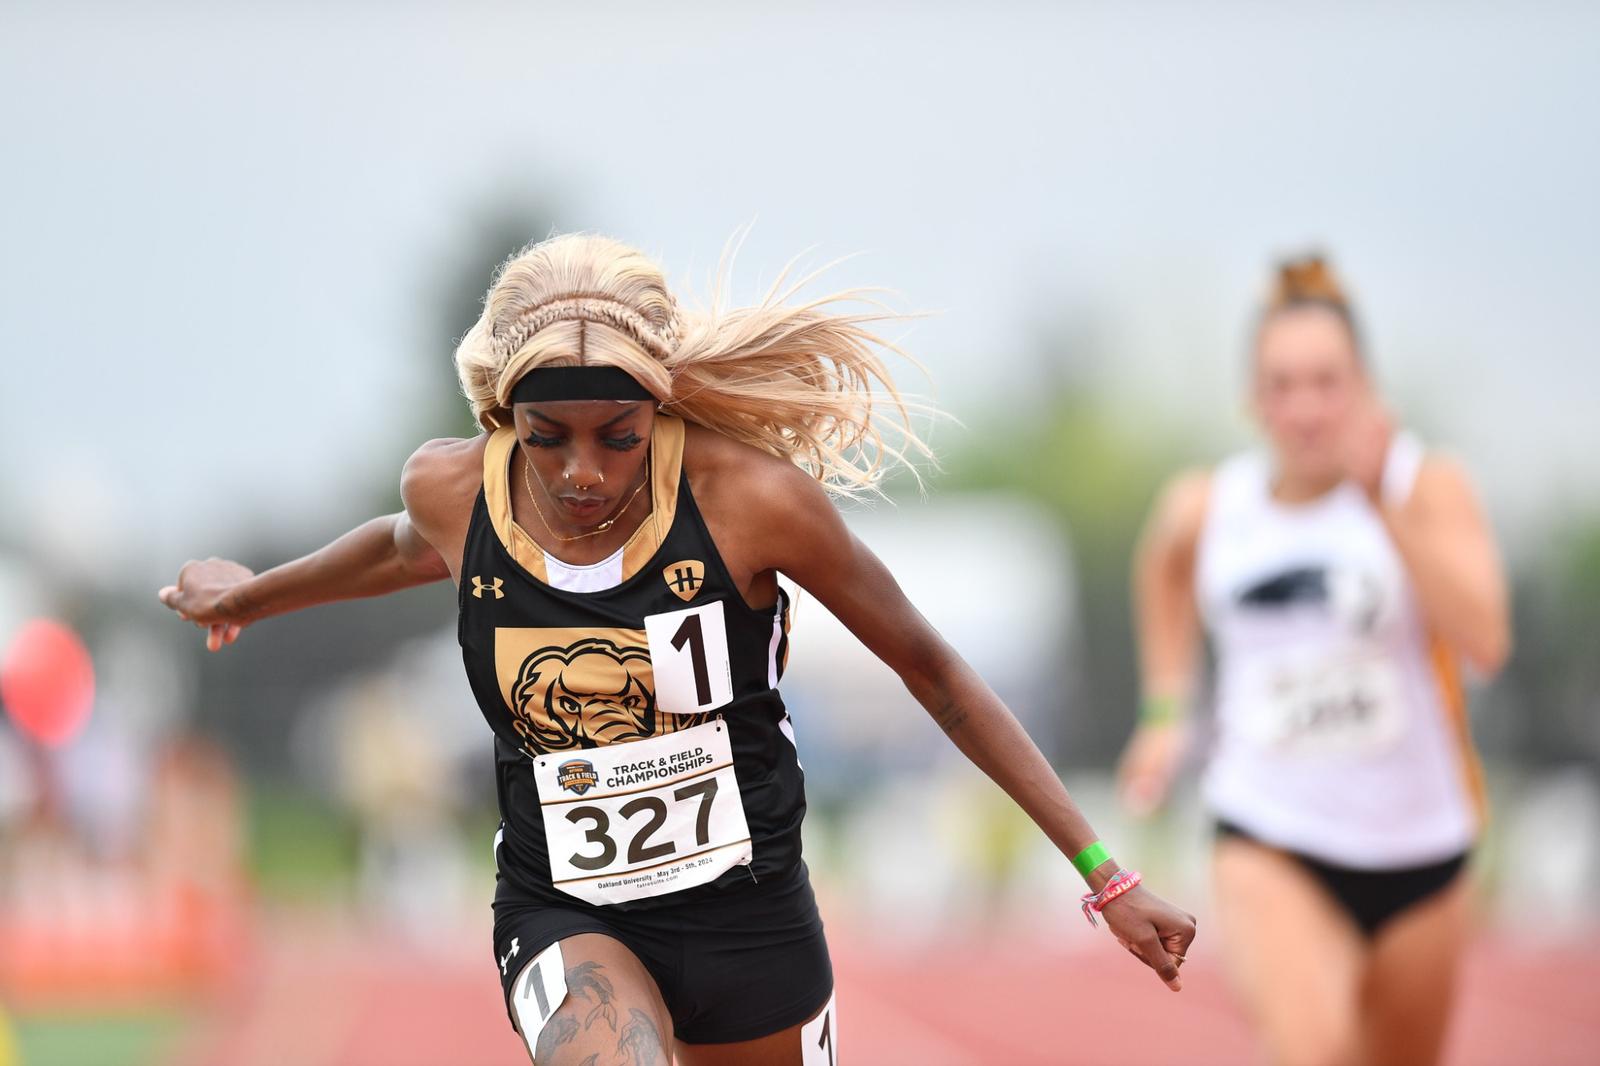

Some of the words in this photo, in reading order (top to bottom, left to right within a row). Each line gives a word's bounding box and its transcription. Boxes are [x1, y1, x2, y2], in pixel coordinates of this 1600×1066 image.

[670, 614, 712, 707] 1
[559, 773, 576, 783] TRACK
[581, 772, 597, 780] FIELD
[606, 754, 714, 788] CHAMPIONSHIPS
[613, 759, 655, 776] TRACK
[658, 757, 667, 767] &
[670, 747, 703, 764] FIELD
[564, 777, 719, 871] 327
[597, 880, 623, 889] Oakland
[623, 873, 652, 886] University
[656, 869, 670, 879] May
[669, 865, 681, 875] 3rd
[698, 856, 714, 867] 2024
[523, 962, 552, 1022] 1
[818, 1010, 834, 1066] 1
